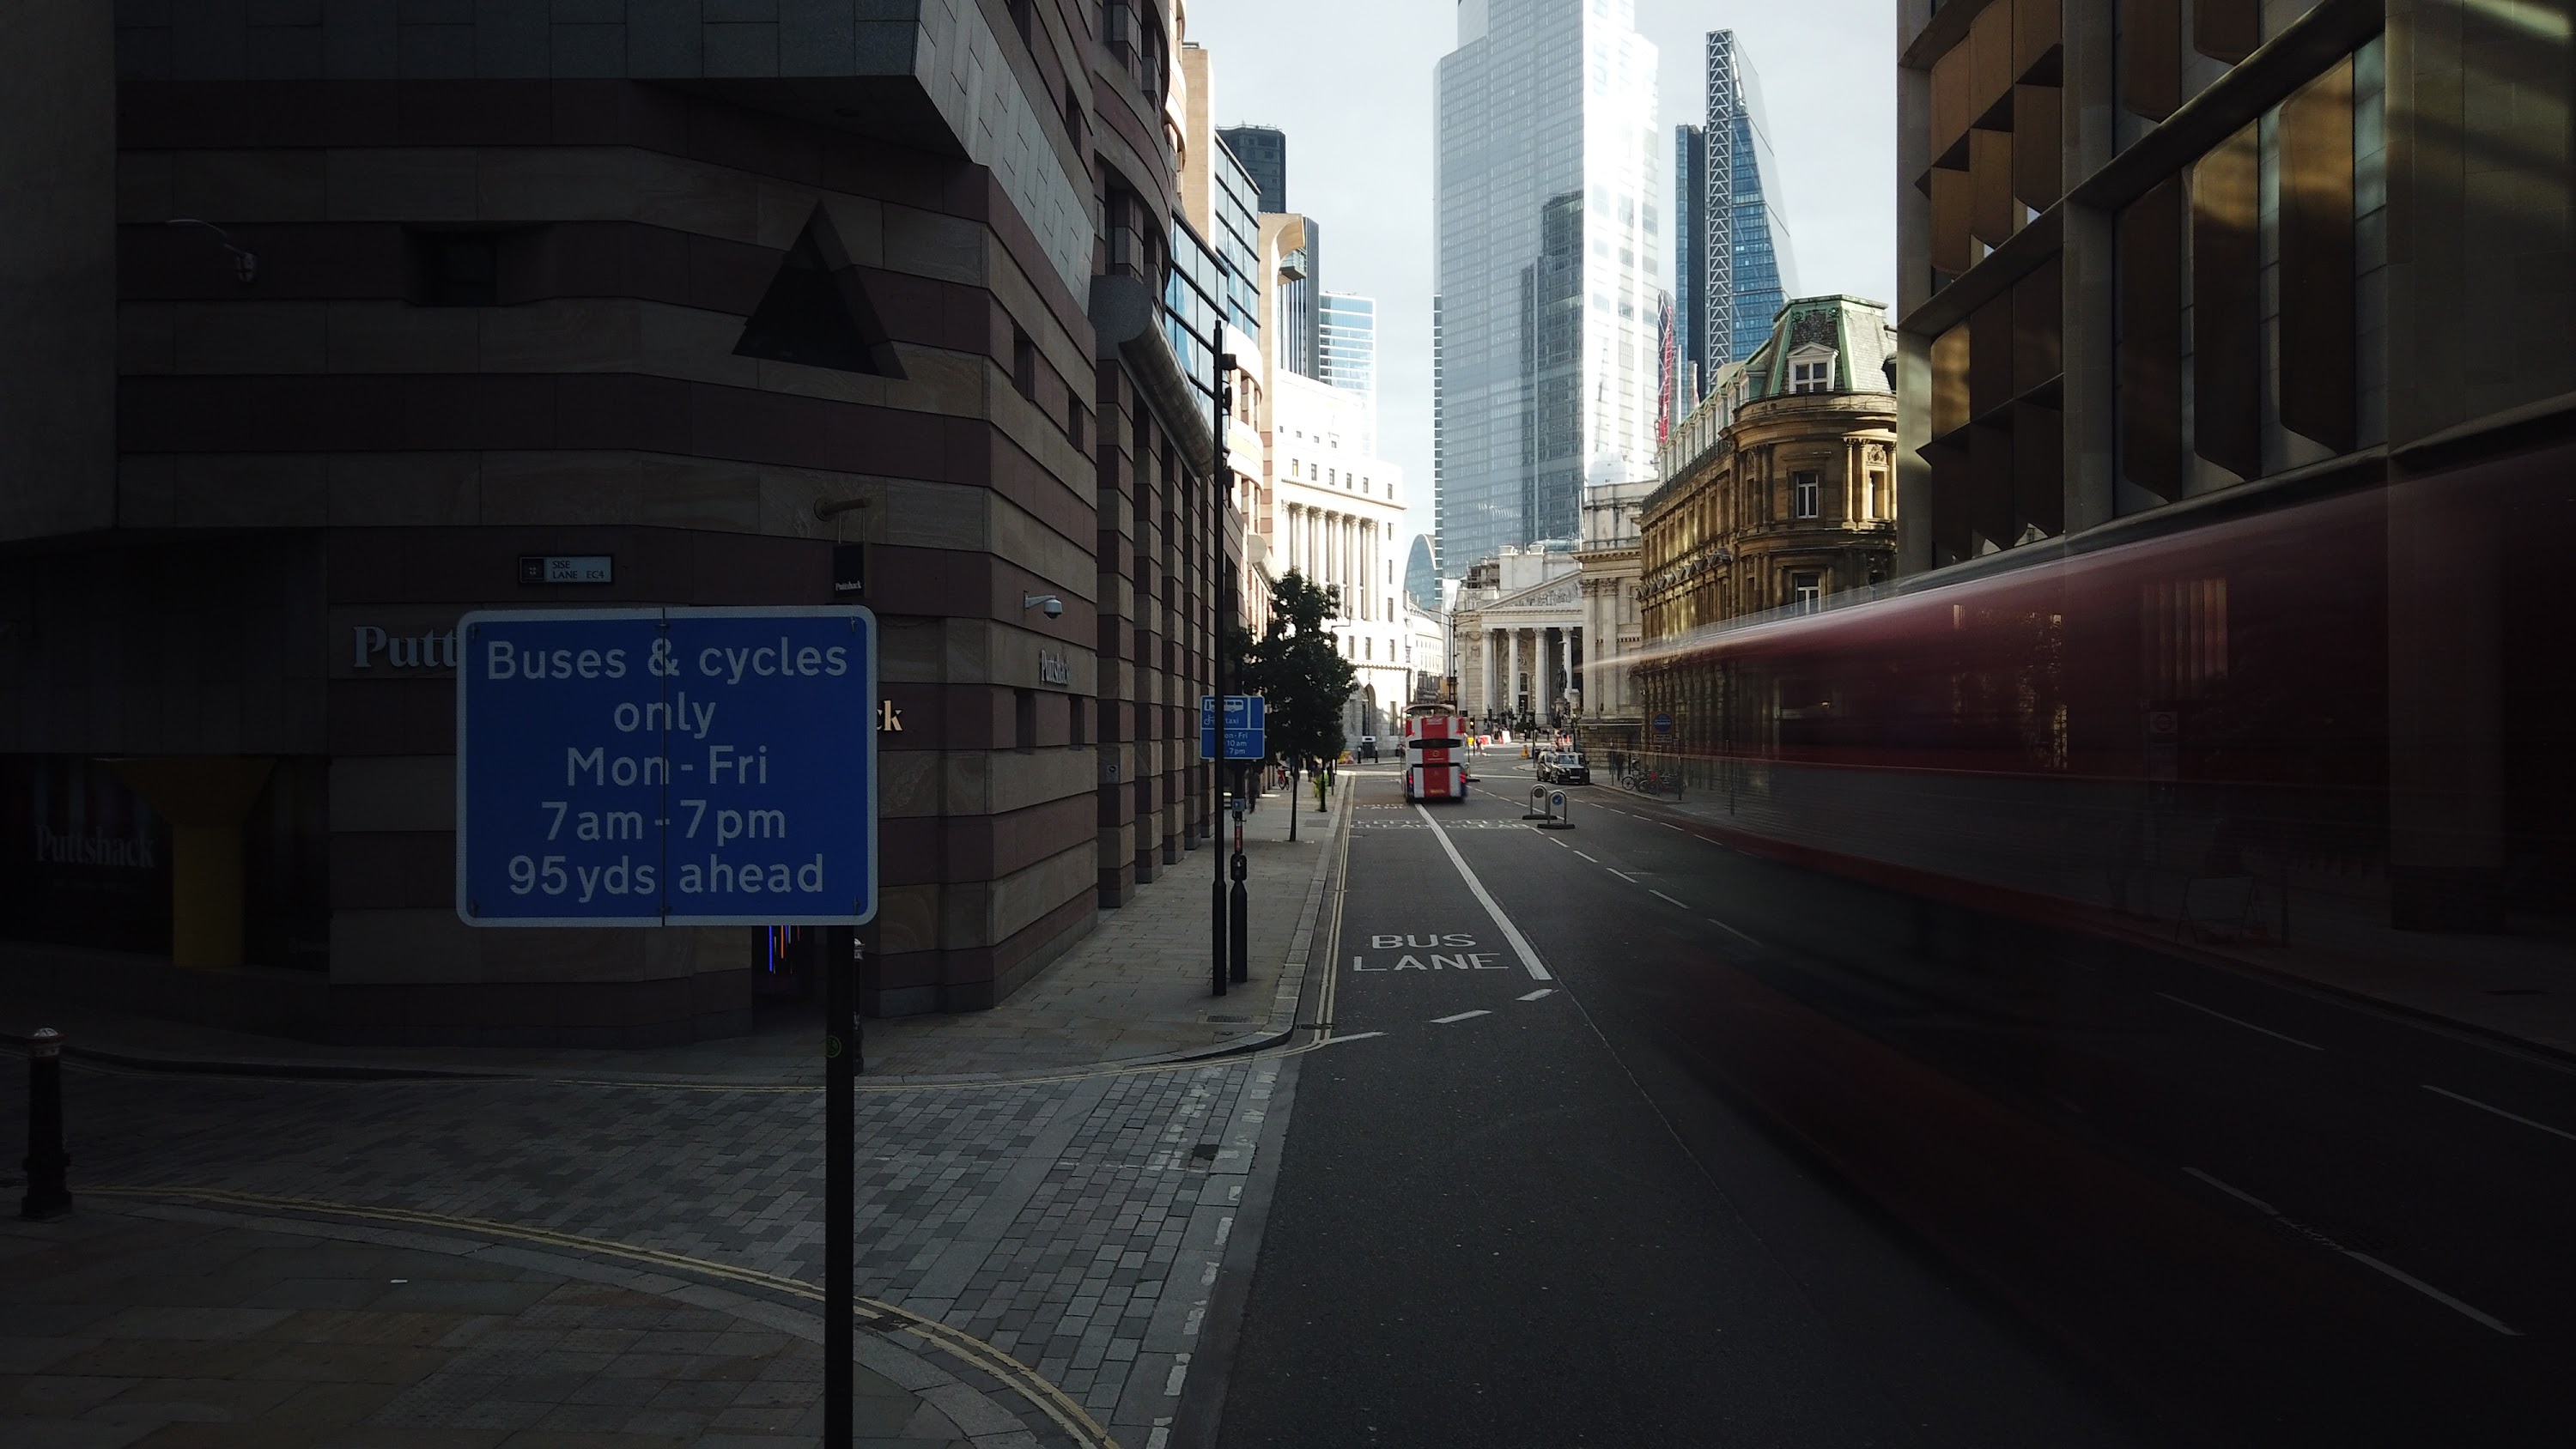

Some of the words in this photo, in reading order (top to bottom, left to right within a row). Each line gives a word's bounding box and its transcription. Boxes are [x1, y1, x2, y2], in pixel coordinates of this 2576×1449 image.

[552, 561, 570, 569] SISE
[552, 571, 577, 579] LANE
[586, 571, 605, 579] EC4
[489, 641, 626, 679] Buses
[647, 638, 680, 676] &
[699, 637, 848, 684] cycles
[613, 691, 716, 739] only
[34, 824, 156, 869] Puttshack
[678, 854, 823, 894] ahead
[1371, 933, 1477, 949] BUS
[1353, 953, 1510, 972] LANE
